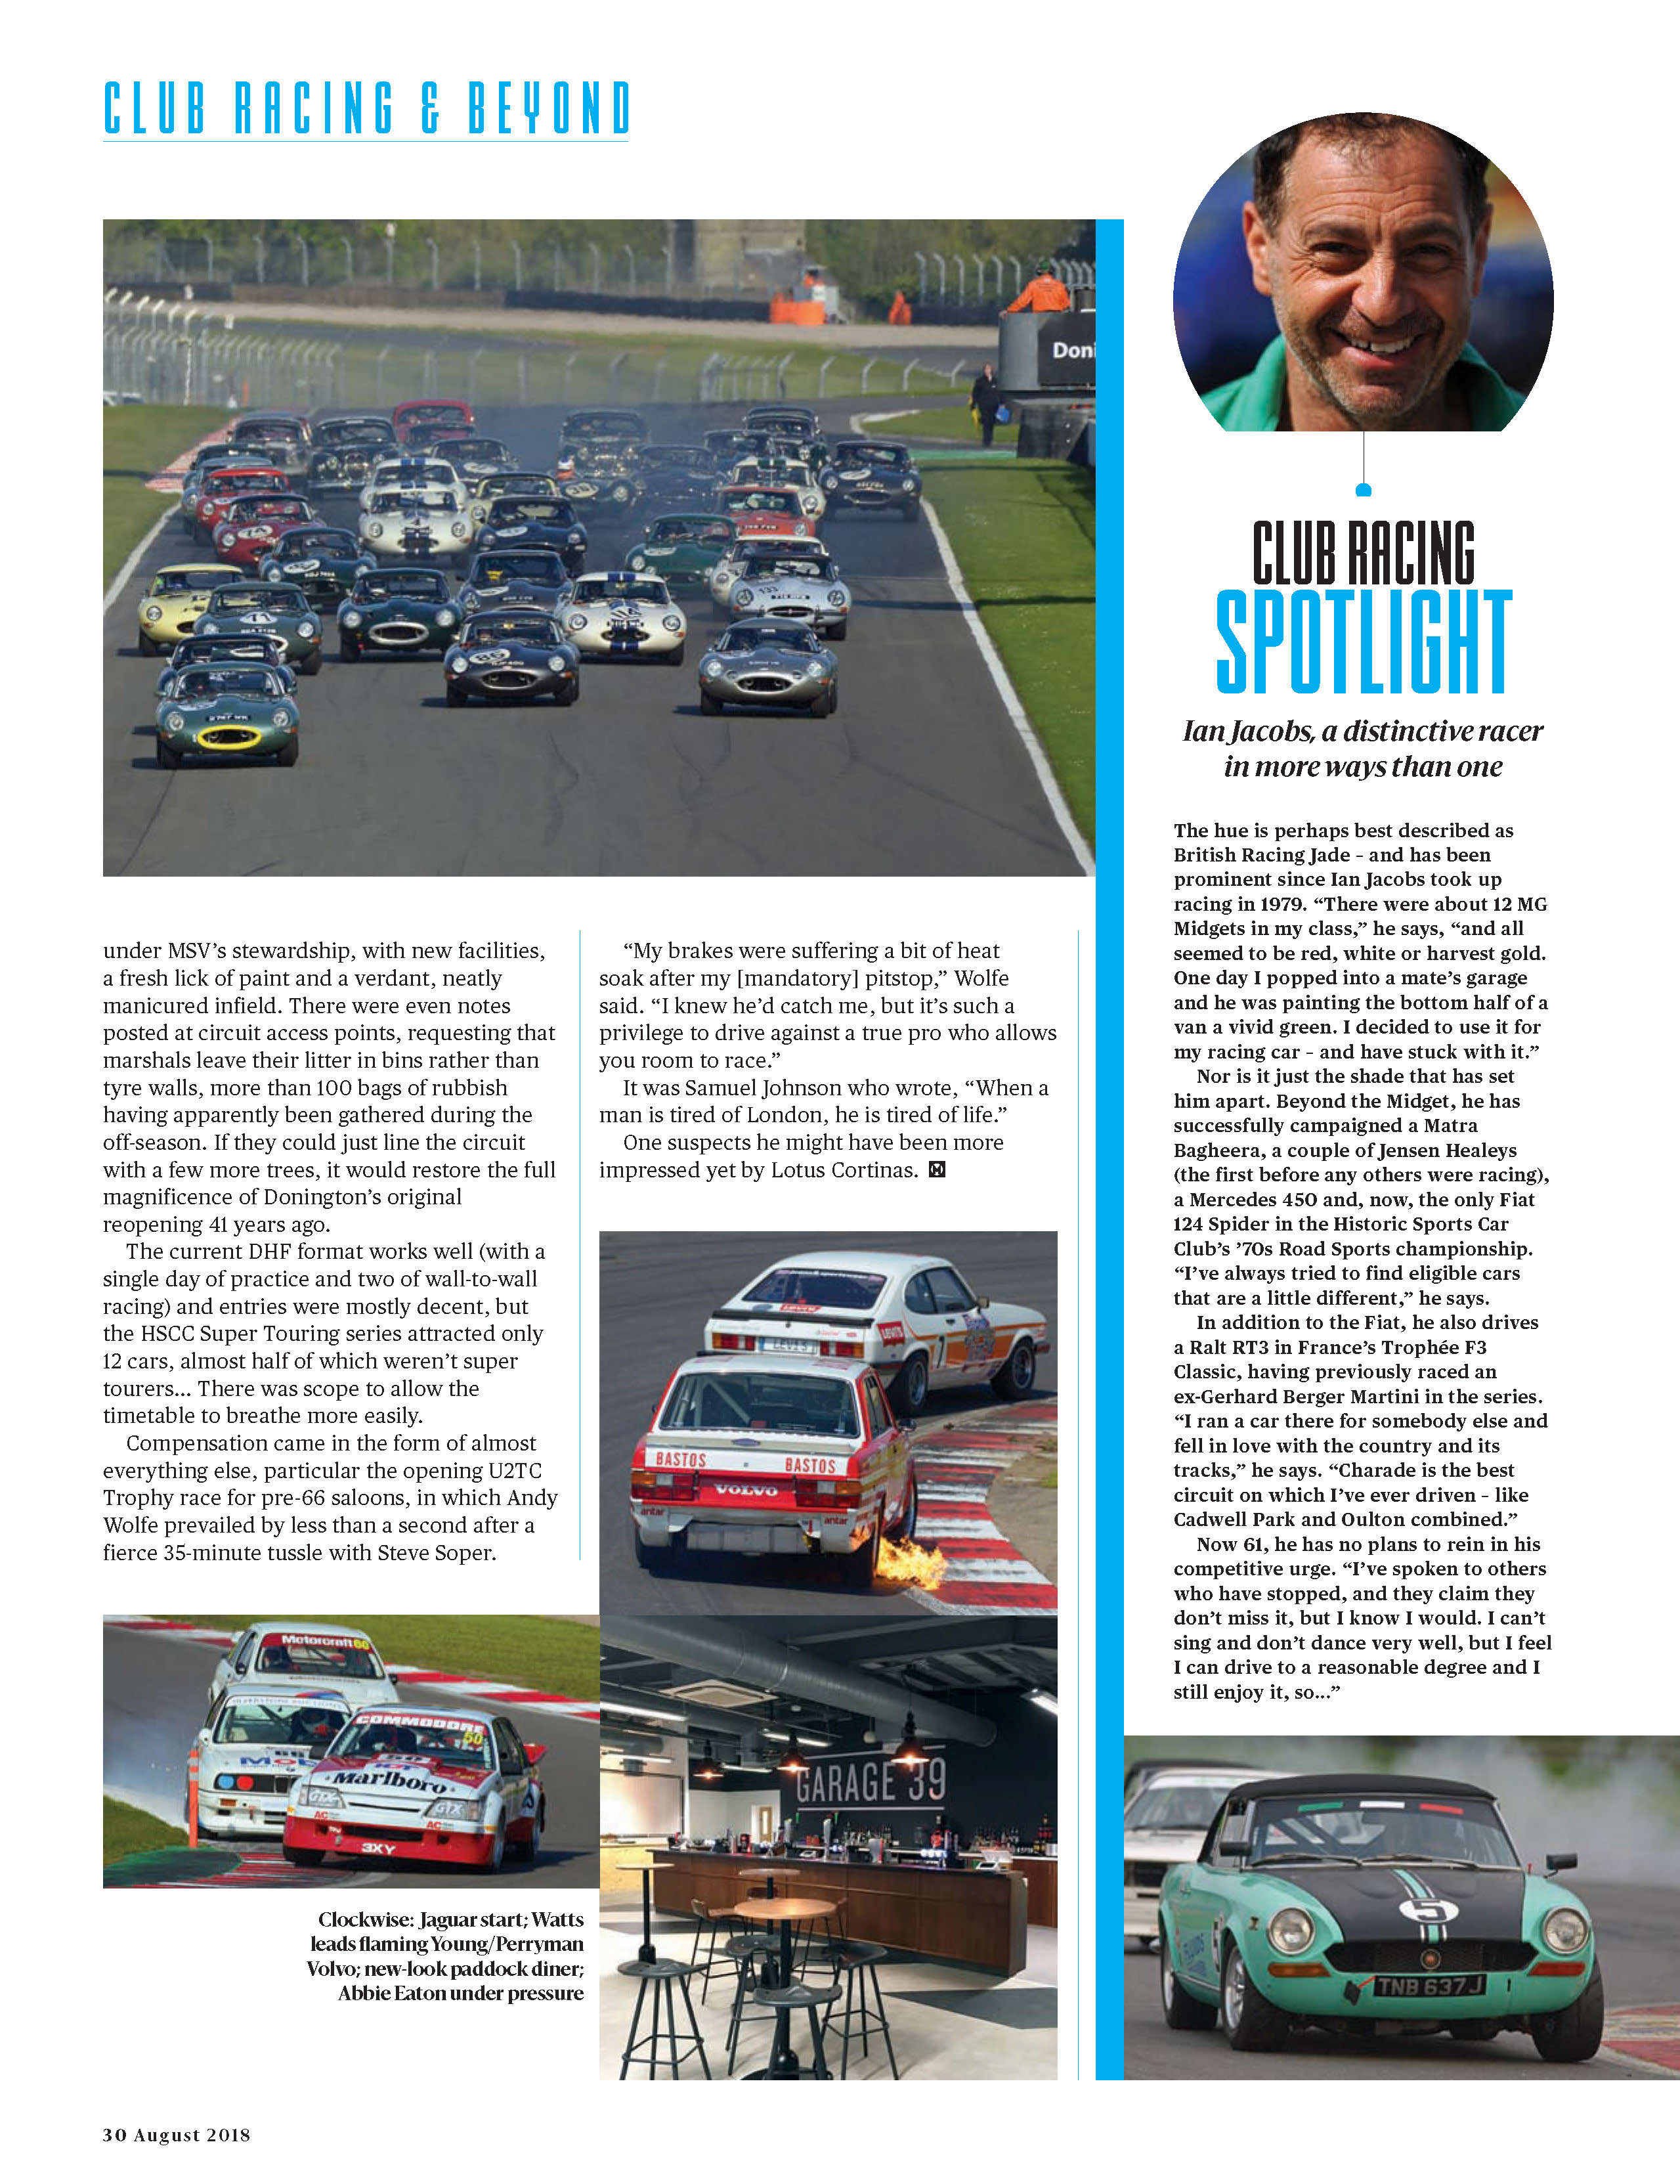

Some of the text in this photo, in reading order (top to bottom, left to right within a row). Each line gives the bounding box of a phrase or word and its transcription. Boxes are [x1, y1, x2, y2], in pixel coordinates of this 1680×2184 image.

[104, 81, 629, 134] CLUB RACING & BEYOND
[1253, 520, 1475, 585] CLUB RACING
[1217, 589, 1513, 694] SPOTLIGHT
[1182, 718, 1545, 746] Ian Jacobs, a distinctive racer
[1224, 754, 1503, 781] in more ways than one
[1174, 822, 1514, 842] The hue is perhaps best described as
[103, 941, 545, 963] under MSV’s stewardship, with new facilities,
[599, 969, 1009, 991] soak after my [mandatory] pitstop,” Wolfe
[599, 1160, 700, 1183] impressed
[706, 1163, 737, 1183] yet
[741, 1160, 765, 1183] by
[771, 1162, 825, 1178] Lotus
[832, 1161, 918, 1178] Cortinas.
[103, 1187, 462, 1210] magnificence of Donington’s original
[1174, 1191, 1536, 1211] a Mercedes 450 and, now, the only Fiat
[1174, 1215, 1509, 1235] 124 Spider in the Historic Sports Car
[103, 1324, 544, 1346] the HSCC Super Touring series attracted only
[1174, 1339, 1487, 1359] a Ralt RT3 in France’s Trophée F3
[103, 1461, 542, 1483] everything else, particular the opening U2TC
[656, 1451, 836, 1474] BASTOS BASTOS
[714, 1483, 779, 1496] VOLVO
[1174, 1511, 1518, 1527] Cadwell Park and Oulton combined.”
[103, 1543, 496, 1565] fierce 35-minute tussle with Steve Soper.
[282, 1634, 353, 1648] Motorcraft
[1174, 1684, 1209, 1699] still
[1214, 1684, 1264, 1703] enjoy
[1270, 1684, 1289, 1703] it,
[356, 1714, 484, 1732] COMMODORE
[333, 1772, 447, 1794] Marlboro
[796, 1757, 946, 1802] GARAGE 39
[362, 1843, 396, 1855] 3XY
[1411, 1898, 1447, 1922] 5
[318, 1911, 584, 1932] Clockwise: Jaguar start; Watts
[311, 1935, 584, 1956] leads flaming Young/Perryman
[306, 1960, 584, 1980] Volvo; new-look paddock diner;
[337, 1984, 584, 2005] Abbie Eaton under pressure
[1379, 1978, 1419, 1996] TNB
[102, 2128, 250, 2146] 30 August 2018
